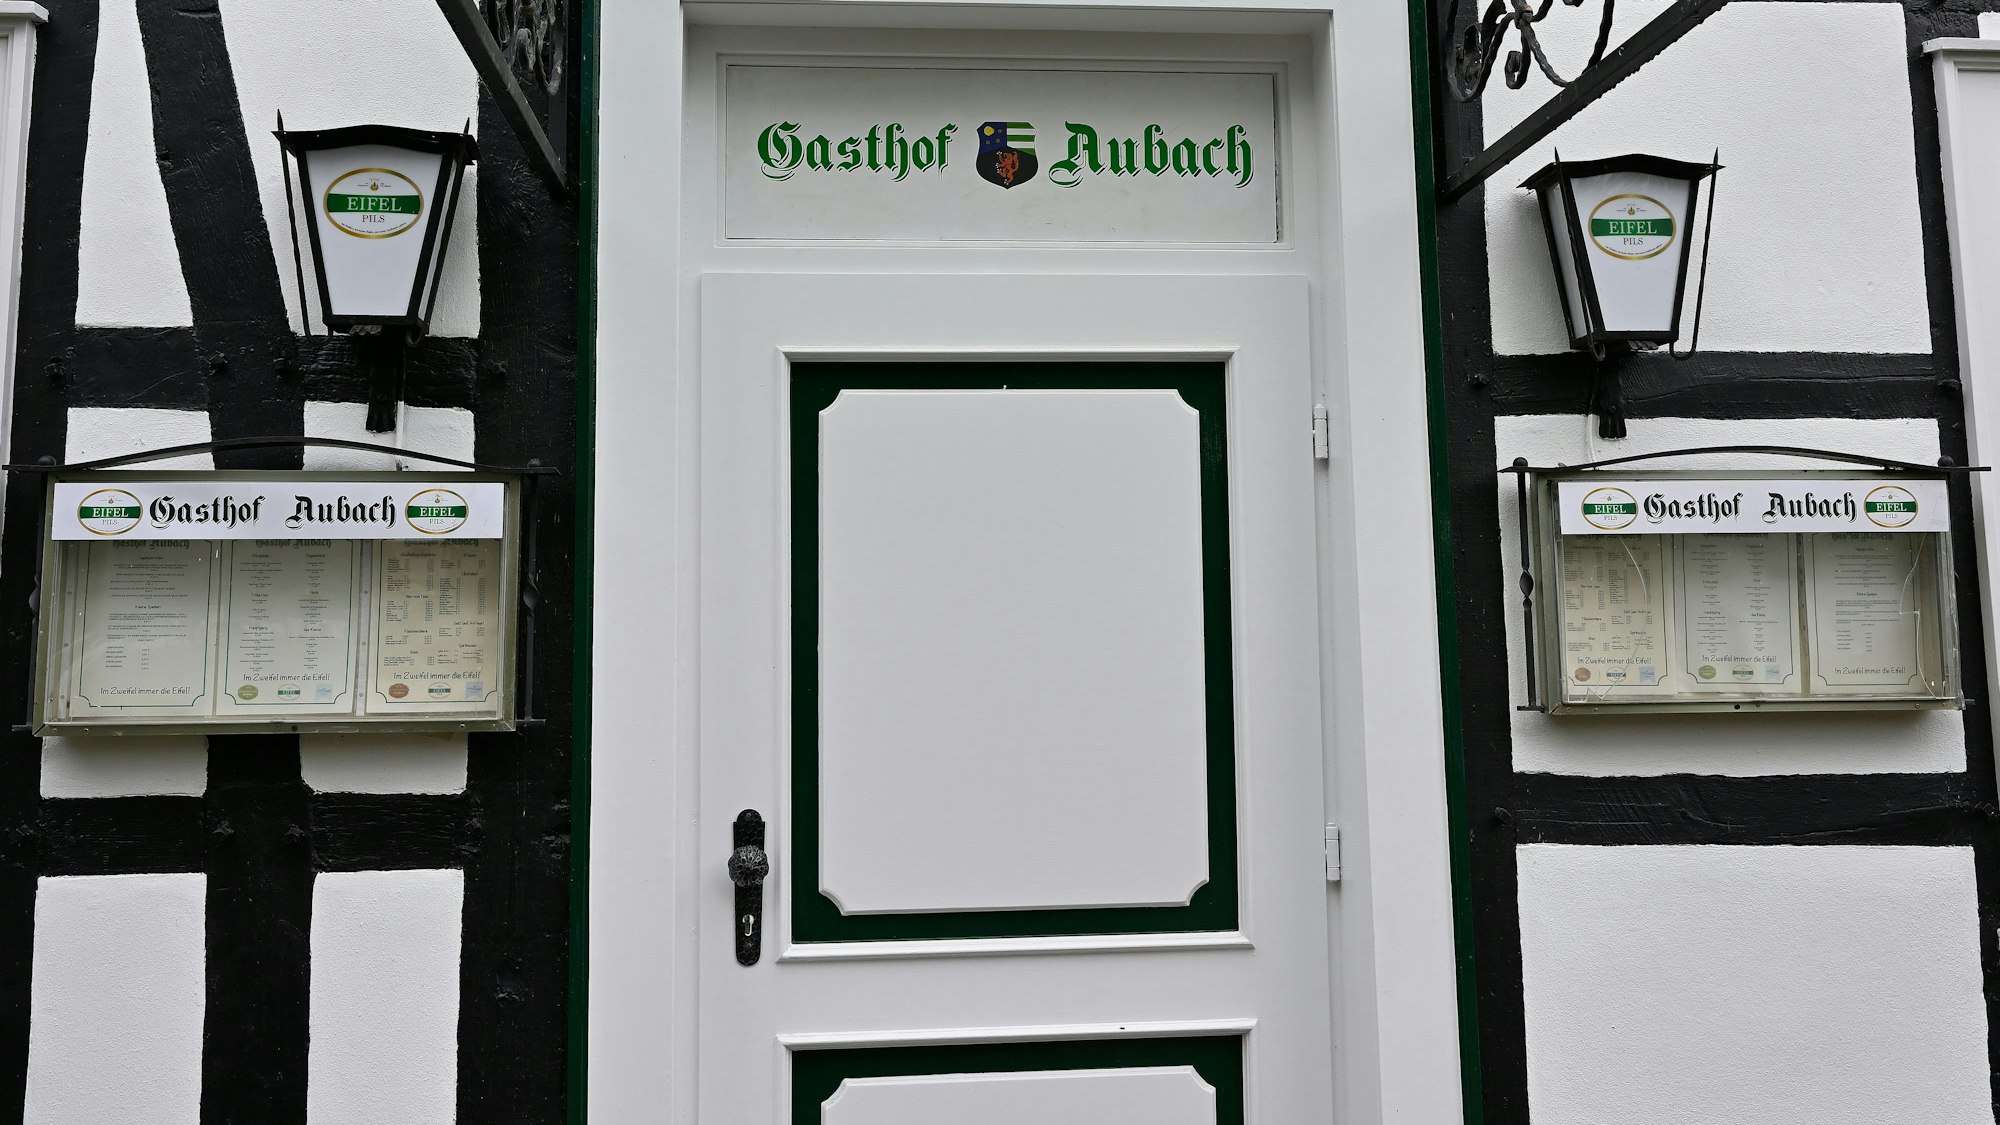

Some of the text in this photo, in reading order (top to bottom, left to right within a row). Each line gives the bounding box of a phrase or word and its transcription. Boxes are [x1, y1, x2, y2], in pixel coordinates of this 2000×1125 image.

[757, 120, 1254, 188] Gasthof Aubach
[347, 196, 402, 211] EIFEL
[362, 214, 385, 222] PILS
[1608, 221, 1657, 234] EIFEL
[1623, 237, 1643, 245] PILS
[92, 507, 129, 518] EIFEL
[149, 494, 397, 530] Gasthof Aubach
[419, 507, 455, 517] EIFEL
[1594, 504, 1626, 514] EIFEL
[1643, 491, 1857, 524] Gasthof Aubach
[1876, 503, 1907, 512] EIFEL
[243, 673, 331, 682] Im Zweifel immer die Eifel!
[393, 671, 480, 680] Im Zweifel immer die Eifel!
[100, 686, 191, 695] Im Zweifel immer die Eifel!
